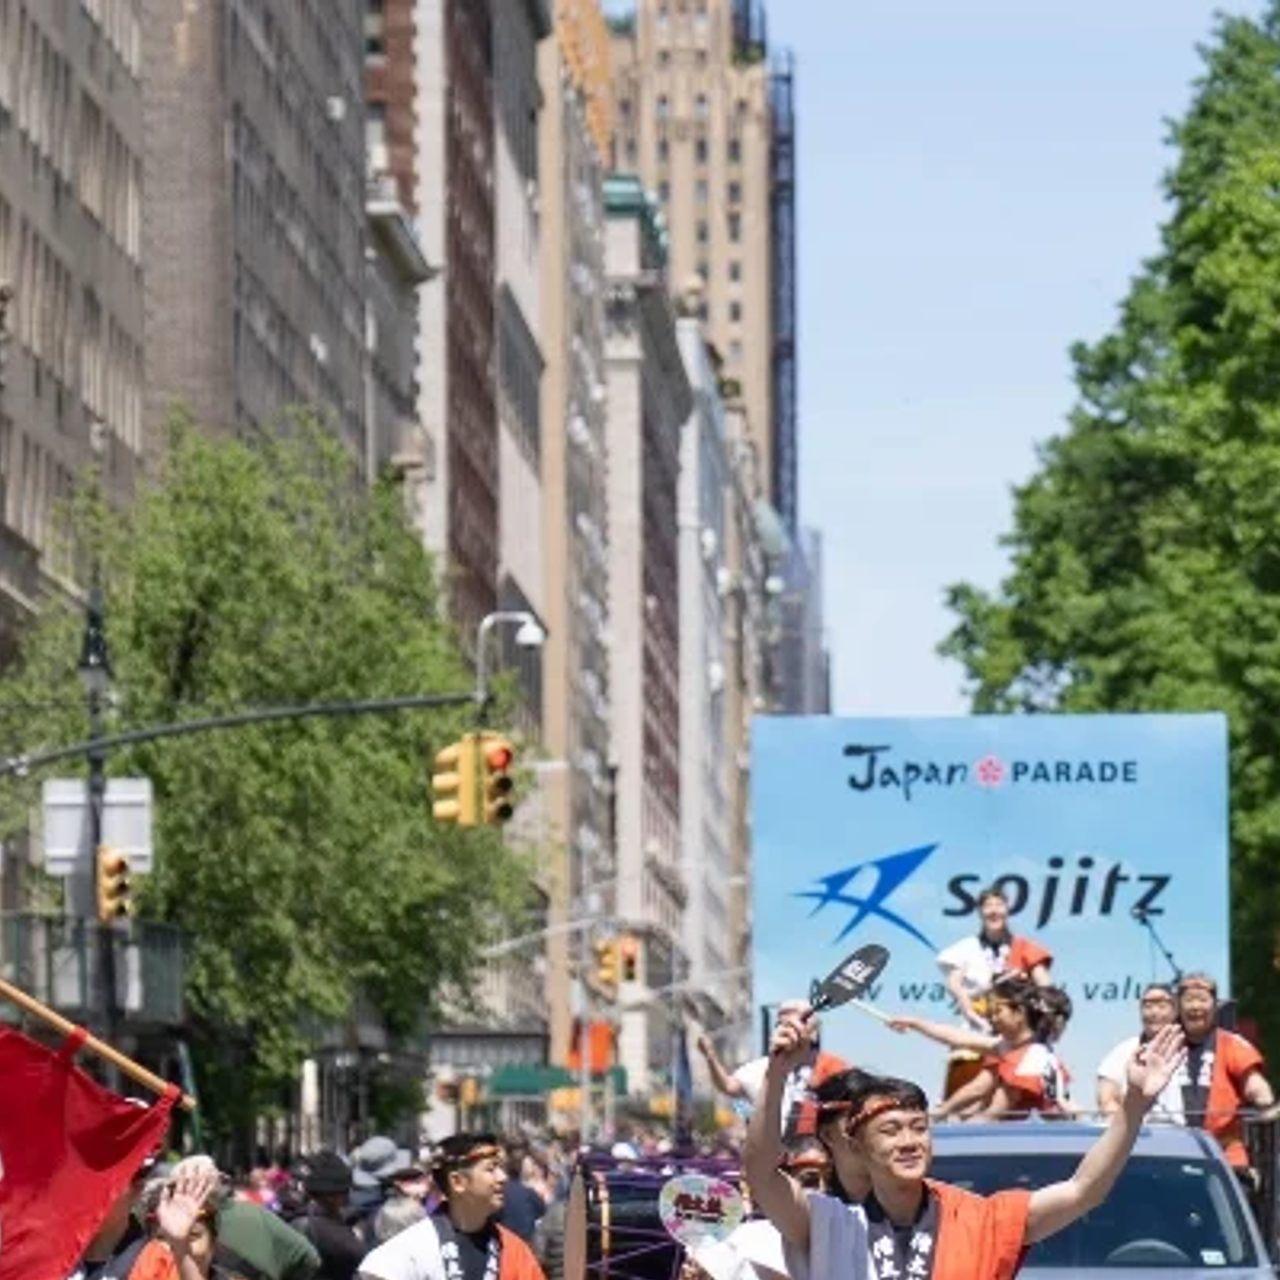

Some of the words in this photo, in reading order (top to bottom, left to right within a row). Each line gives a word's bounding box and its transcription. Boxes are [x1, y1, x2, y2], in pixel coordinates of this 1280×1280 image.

[842, 744, 968, 801] Japan
[1011, 760, 1138, 783] PARADE
[942, 855, 1173, 930] sojitz
